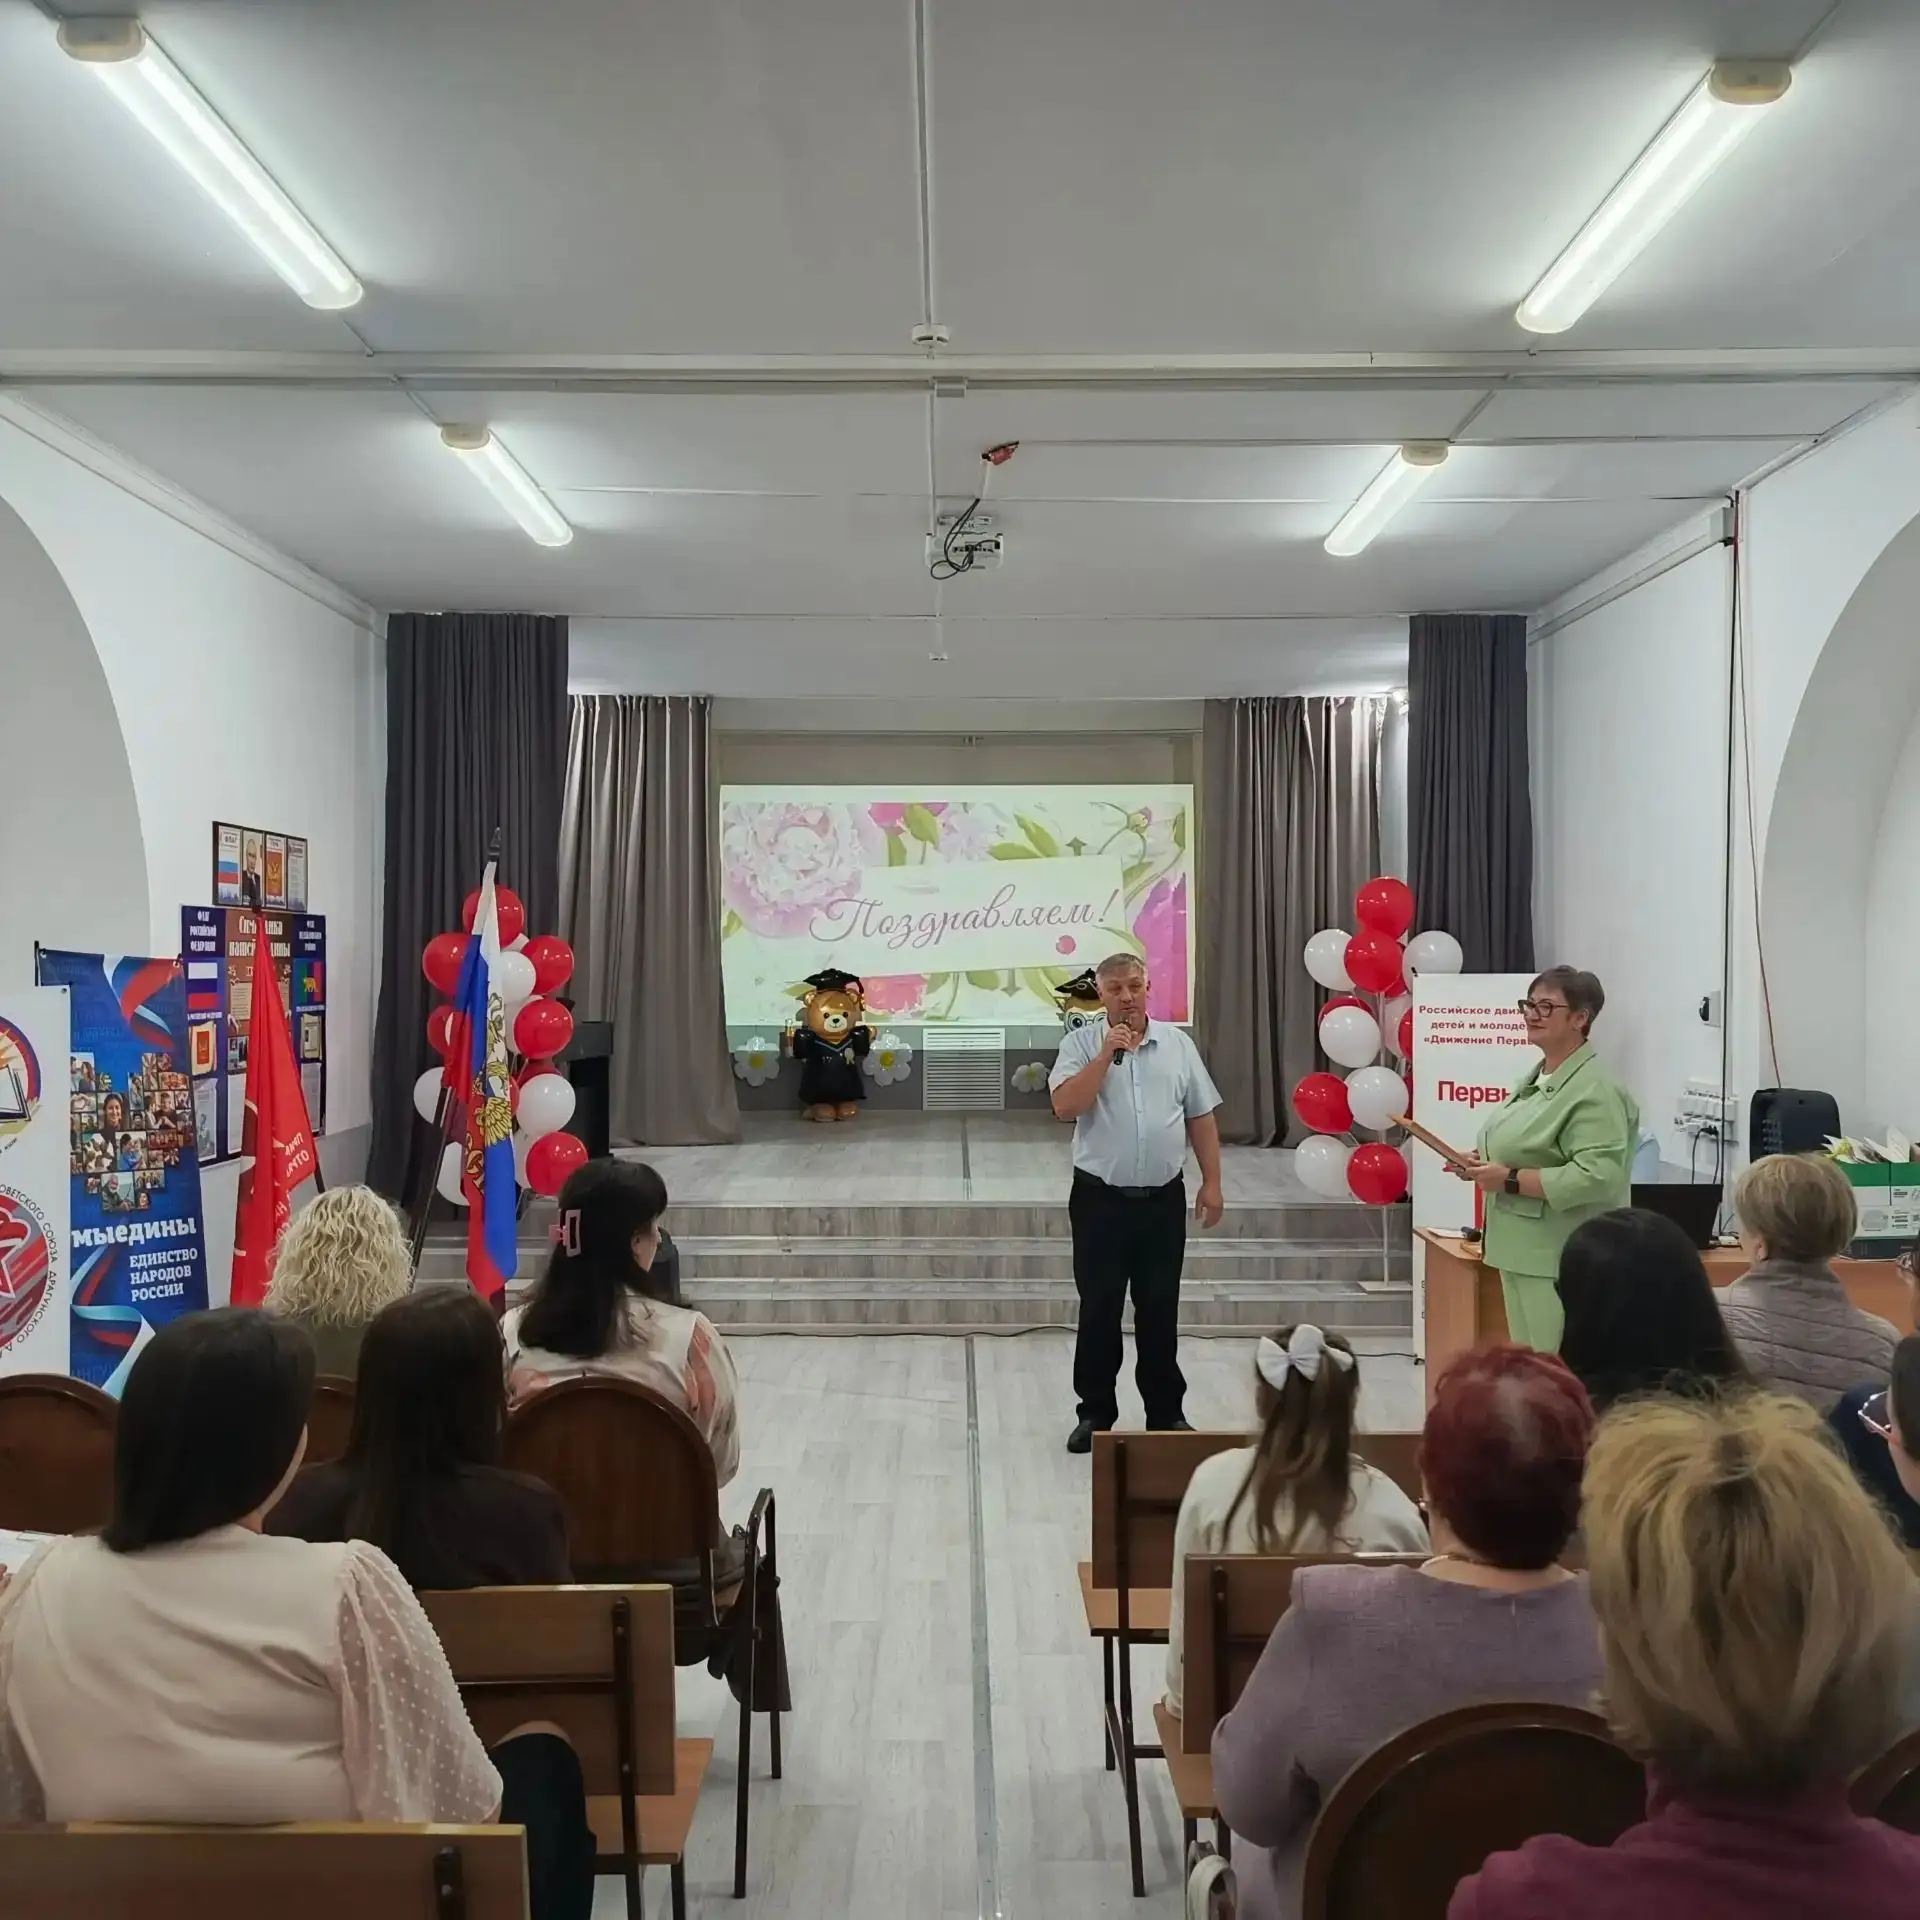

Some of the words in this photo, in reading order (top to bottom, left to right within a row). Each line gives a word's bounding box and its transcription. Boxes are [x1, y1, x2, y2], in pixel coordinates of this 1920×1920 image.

[809, 884, 1120, 950] Поздравляем!
[1419, 1005, 1491, 1015] Российское
[1431, 1021, 1465, 1029] детей
[1480, 1022, 1526, 1031] молоде
[1424, 1035, 1493, 1045] «Движение
[0, 1184, 44, 1220] ОВЕТСКОГО
[43, 1222, 58, 1263] СОЮЗА
[71, 1217, 197, 1248] мыедины
[129, 1248, 198, 1269] ЕДИНСТВО
[130, 1265, 192, 1285] НАРОДОВ
[131, 1283, 184, 1302] РОССИИ
[16, 1270, 57, 1344] ДРАГУНСКОГО
